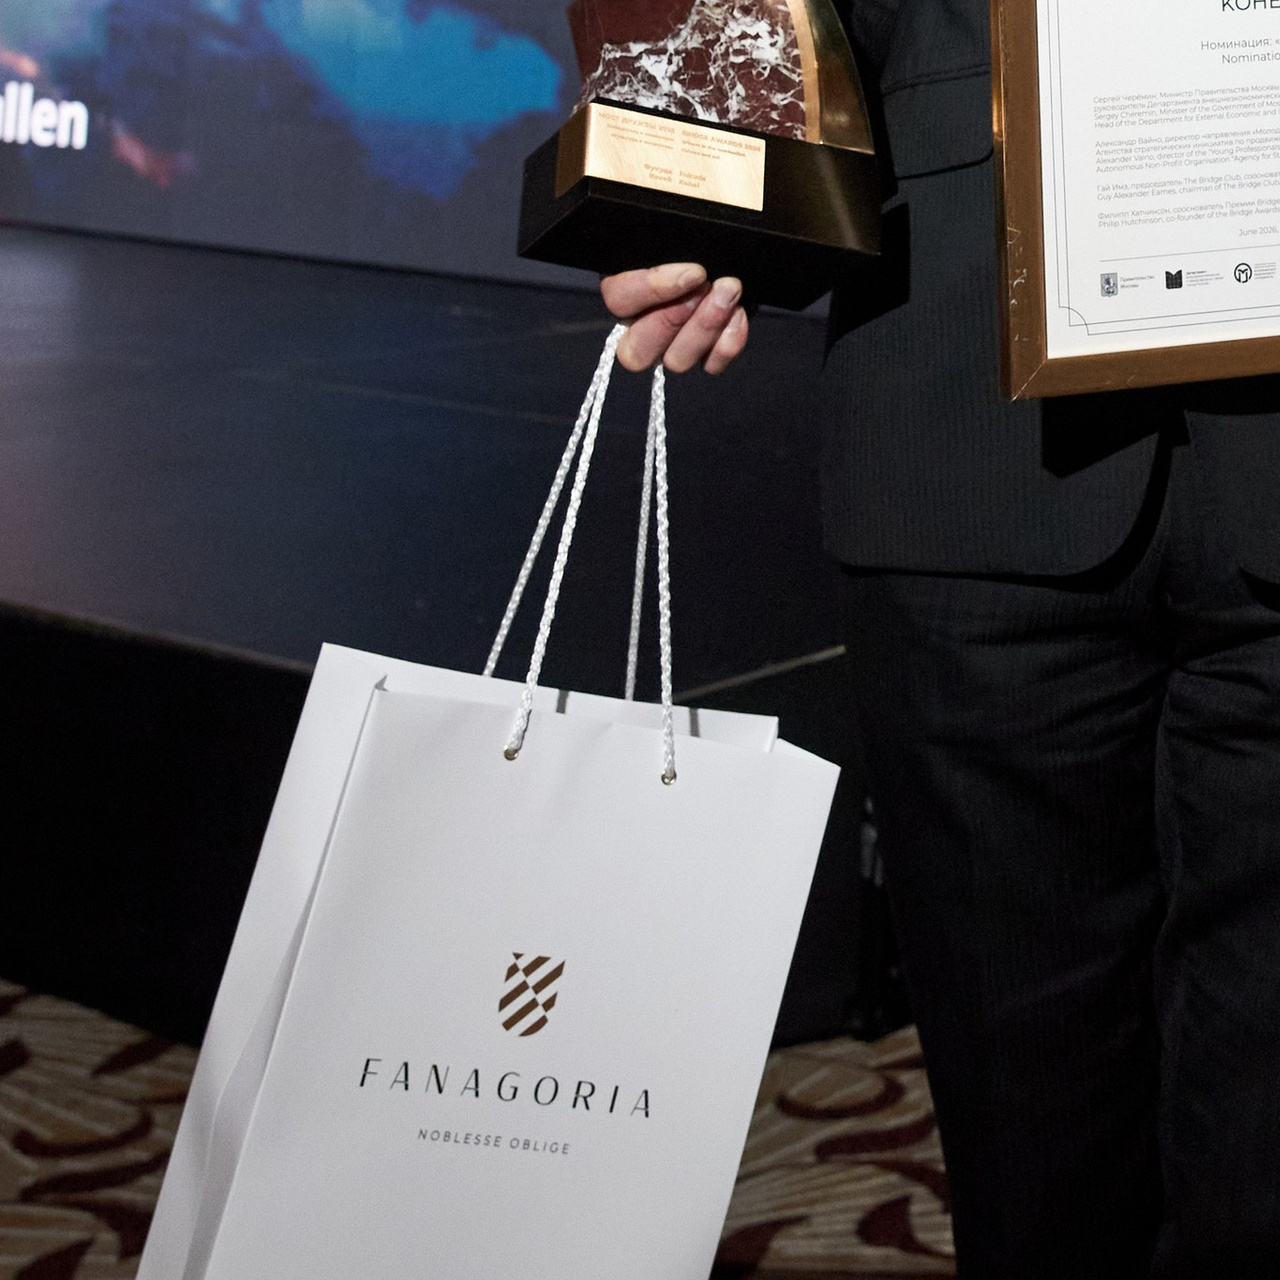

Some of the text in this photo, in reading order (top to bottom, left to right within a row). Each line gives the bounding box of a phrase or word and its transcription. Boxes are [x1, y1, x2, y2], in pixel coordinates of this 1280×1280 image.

[1200, 37, 1271, 49] Номинация:
[0, 80, 89, 150] llen
[359, 1057, 650, 1118] FANAGORIA
[417, 1128, 571, 1155] NOBLESSE OBLIGE
